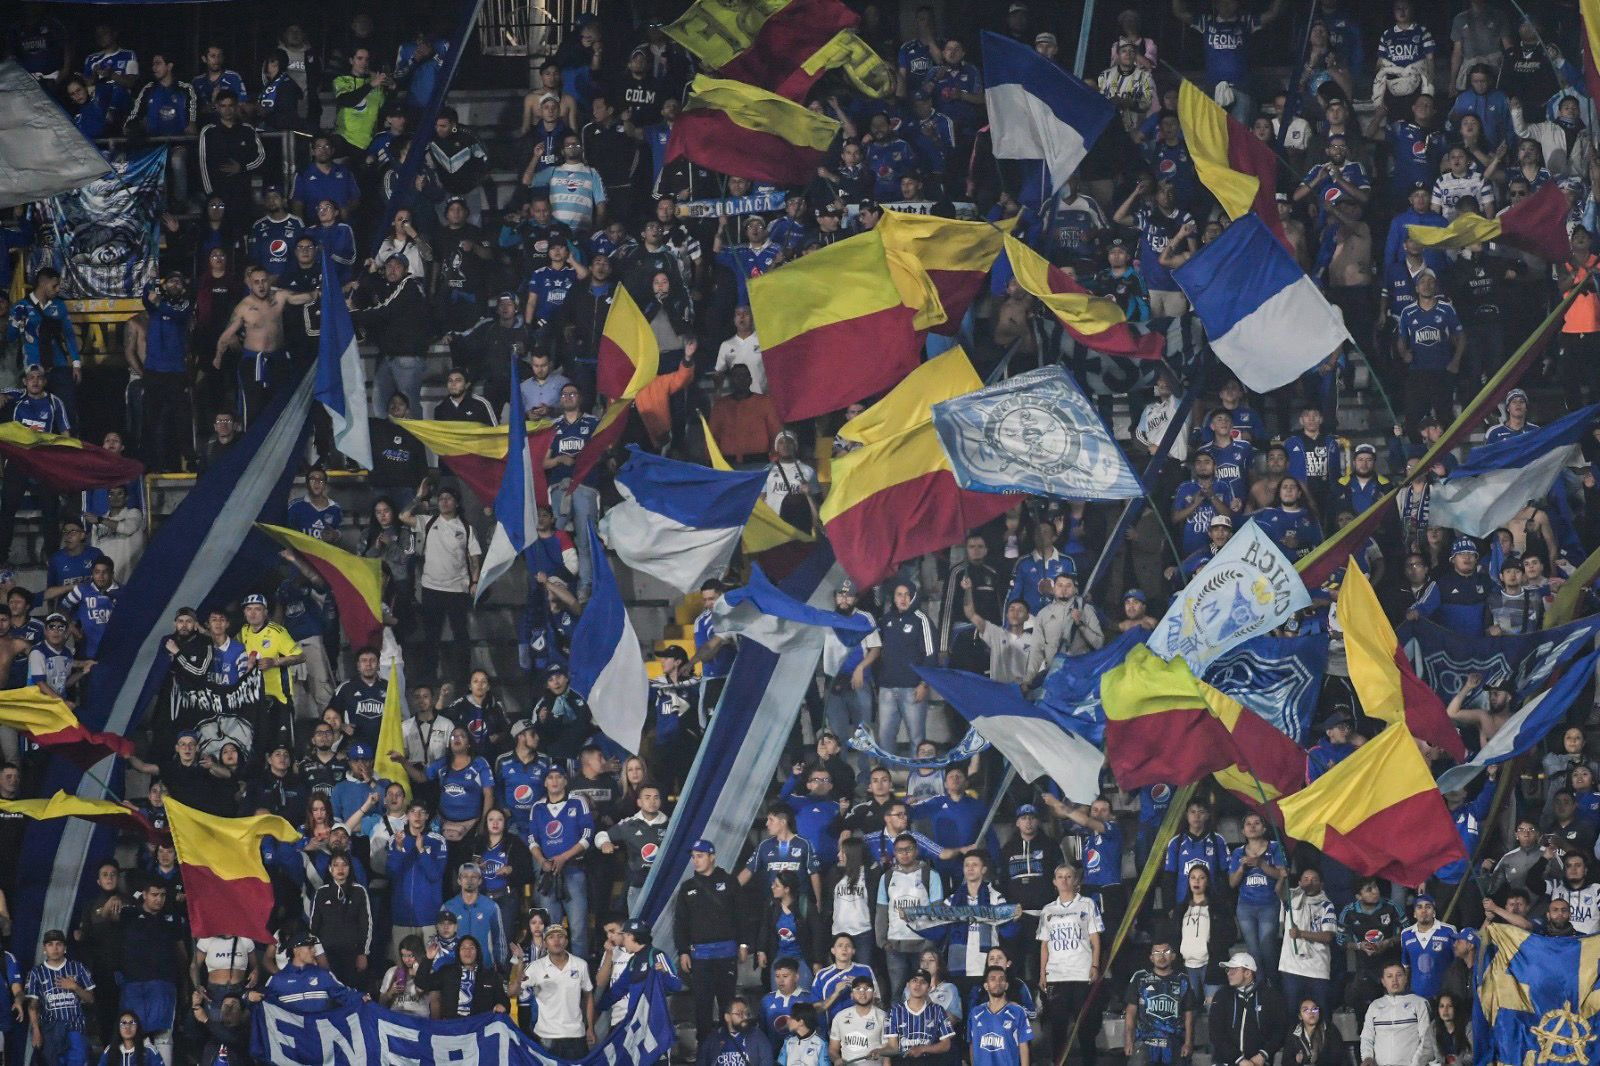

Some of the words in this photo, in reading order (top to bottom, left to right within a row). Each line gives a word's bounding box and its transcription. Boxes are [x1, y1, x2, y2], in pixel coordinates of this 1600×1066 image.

[1208, 34, 1243, 47] LEONA
[625, 88, 656, 104] CDLM
[547, 292, 566, 301] ANDIN
[1415, 330, 1440, 343] ANDINA
[559, 439, 585, 452] ANDINA
[86, 597, 97, 609] 10
[767, 862, 801, 871] PEPSI
[1246, 876, 1267, 886] ANDINA
[1053, 939, 1079, 951] ORO
[1147, 998, 1178, 1015] ANDINA
[844, 1036, 869, 1048] ANDINA
[980, 1035, 1004, 1049] ANDINA
[717, 1054, 748, 1064] CRISTA
